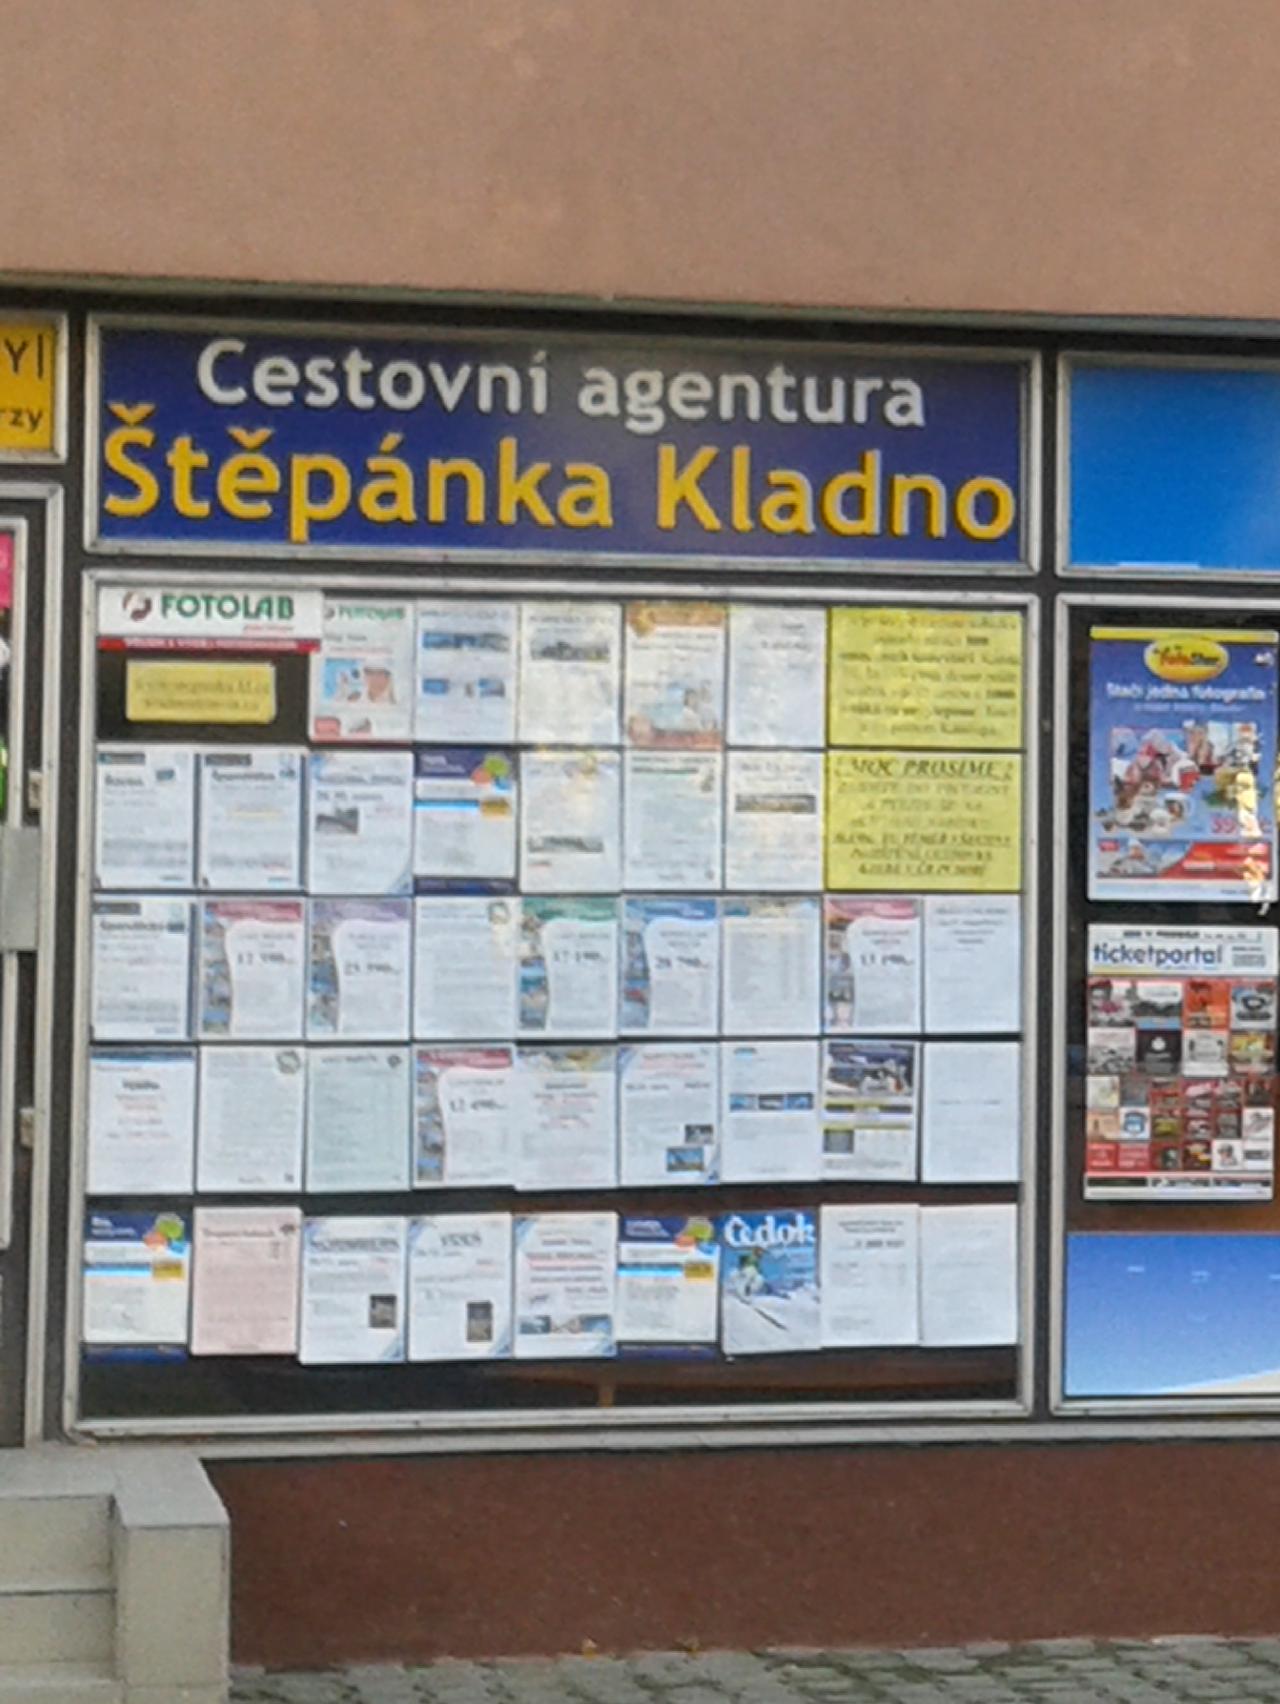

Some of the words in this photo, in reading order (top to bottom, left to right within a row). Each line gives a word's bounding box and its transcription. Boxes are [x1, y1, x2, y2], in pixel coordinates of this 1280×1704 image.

[196, 338, 548, 415] Cestovní
[577, 363, 927, 435] agentura
[103, 402, 614, 544] Štěpánka
[655, 442, 1016, 541] Kladno
[160, 594, 295, 620] FOTOLAB
[1093, 942, 1222, 966] ticketportal
